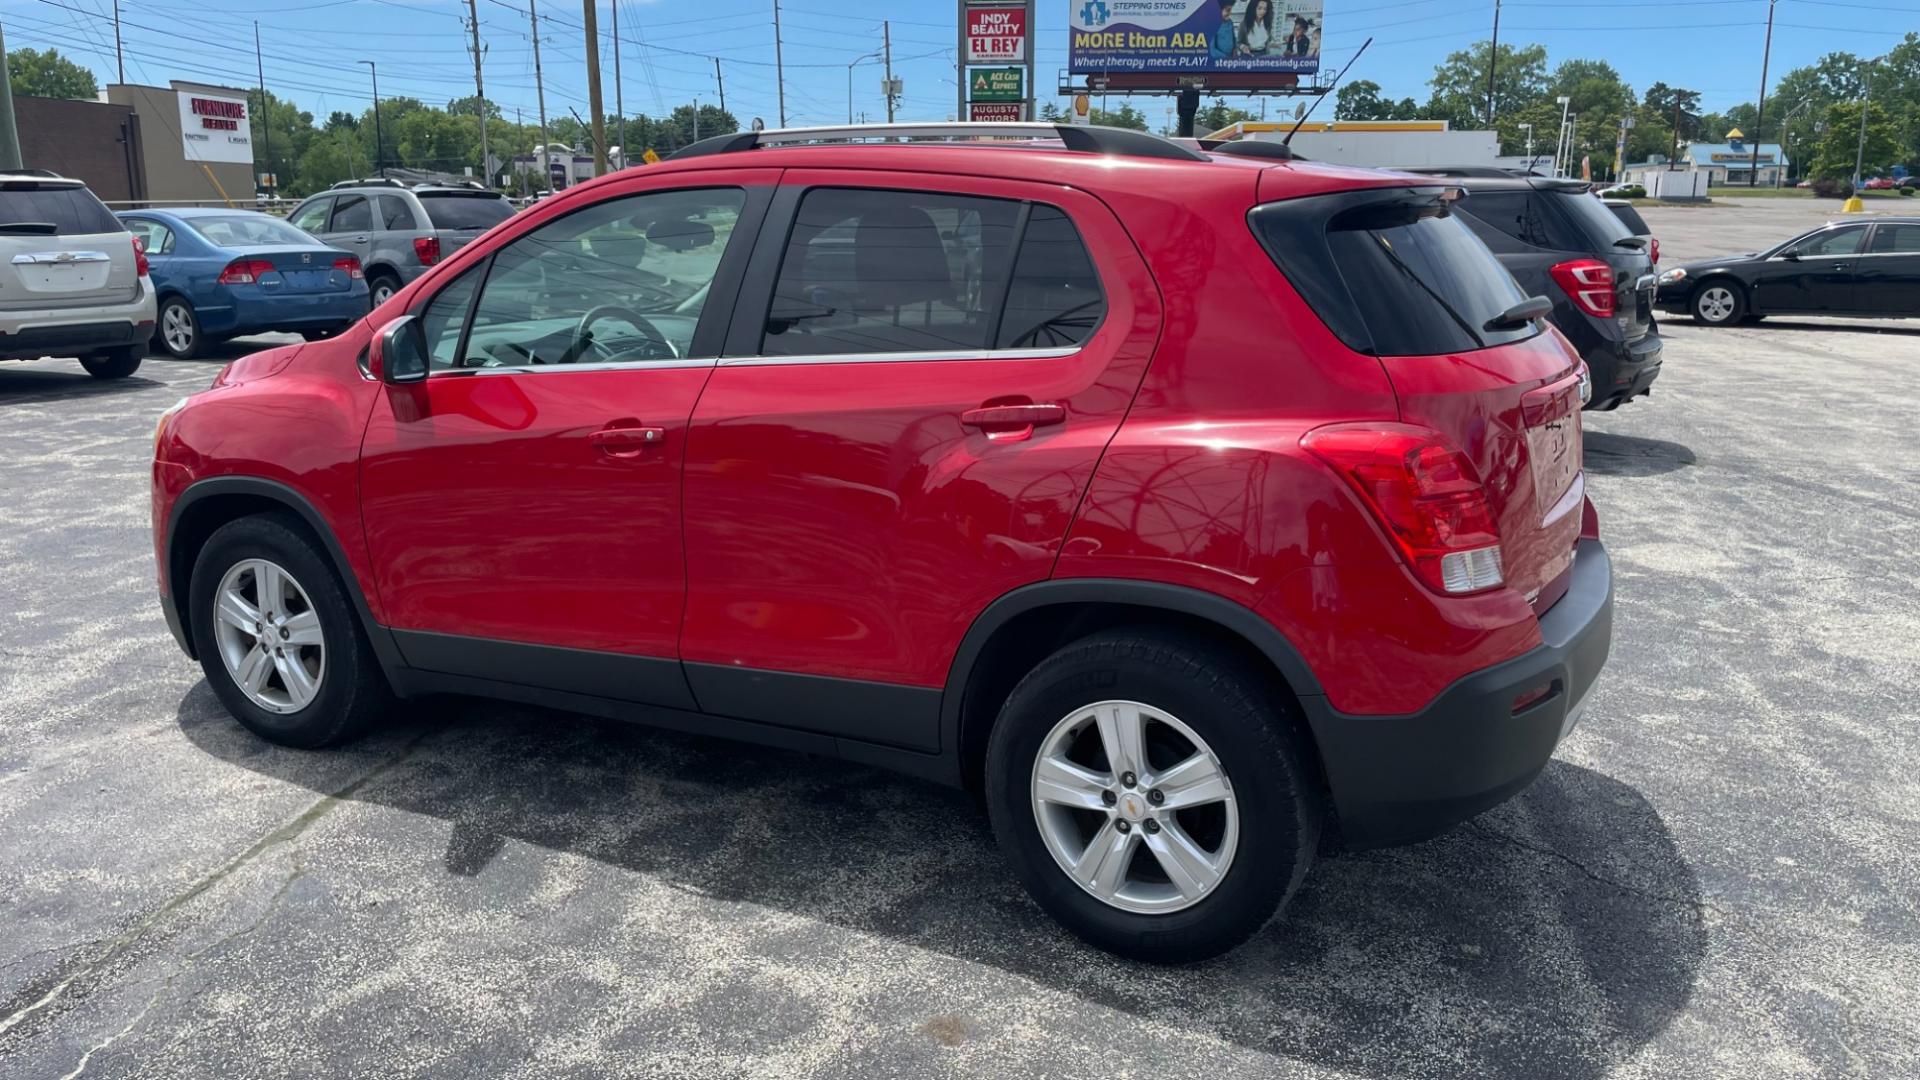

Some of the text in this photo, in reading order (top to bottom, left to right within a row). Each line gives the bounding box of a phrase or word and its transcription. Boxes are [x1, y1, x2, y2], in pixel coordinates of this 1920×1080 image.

[1113, 2, 1186, 10] STEPPING STONES
[981, 14, 1010, 24] INDY
[971, 24, 1020, 34] BEAUTY
[972, 39, 1019, 53] EL REY
[1075, 32, 1208, 48] MORE than ABA
[1074, 56, 1208, 69] Where therapy meets PLAY!
[1215, 58, 1318, 70] steppingstonesindy.com
